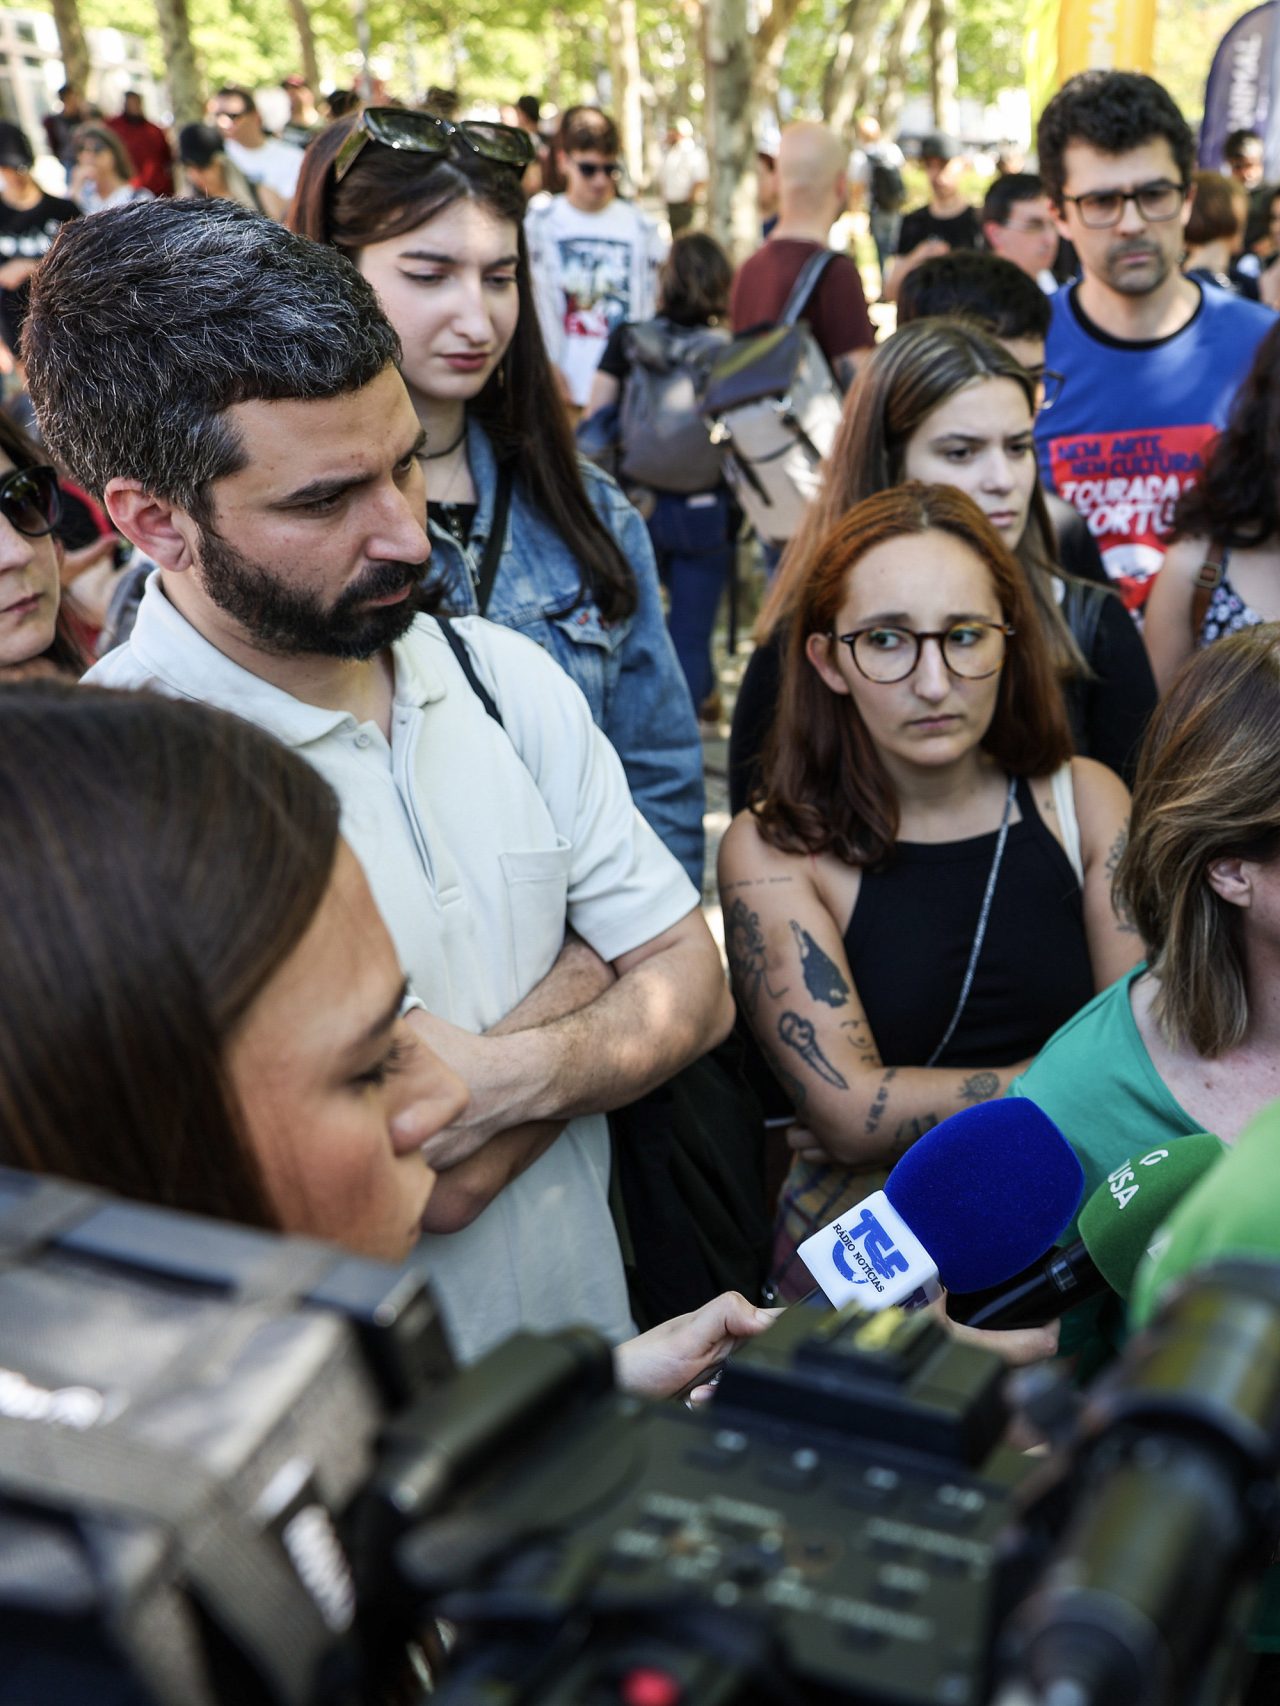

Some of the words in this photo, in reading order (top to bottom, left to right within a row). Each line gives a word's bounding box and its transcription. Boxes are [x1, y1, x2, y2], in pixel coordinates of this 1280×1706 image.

[1111, 452, 1203, 477] CULTURA
[1112, 435, 1161, 454] ARTE
[1061, 474, 1180, 503] TOURADA
[1107, 1158, 1140, 1210] USA
[832, 1223, 856, 1252] RÁDIO
[853, 1251, 885, 1293] NOTÍCIAS
[847, 1208, 909, 1281] TSF
